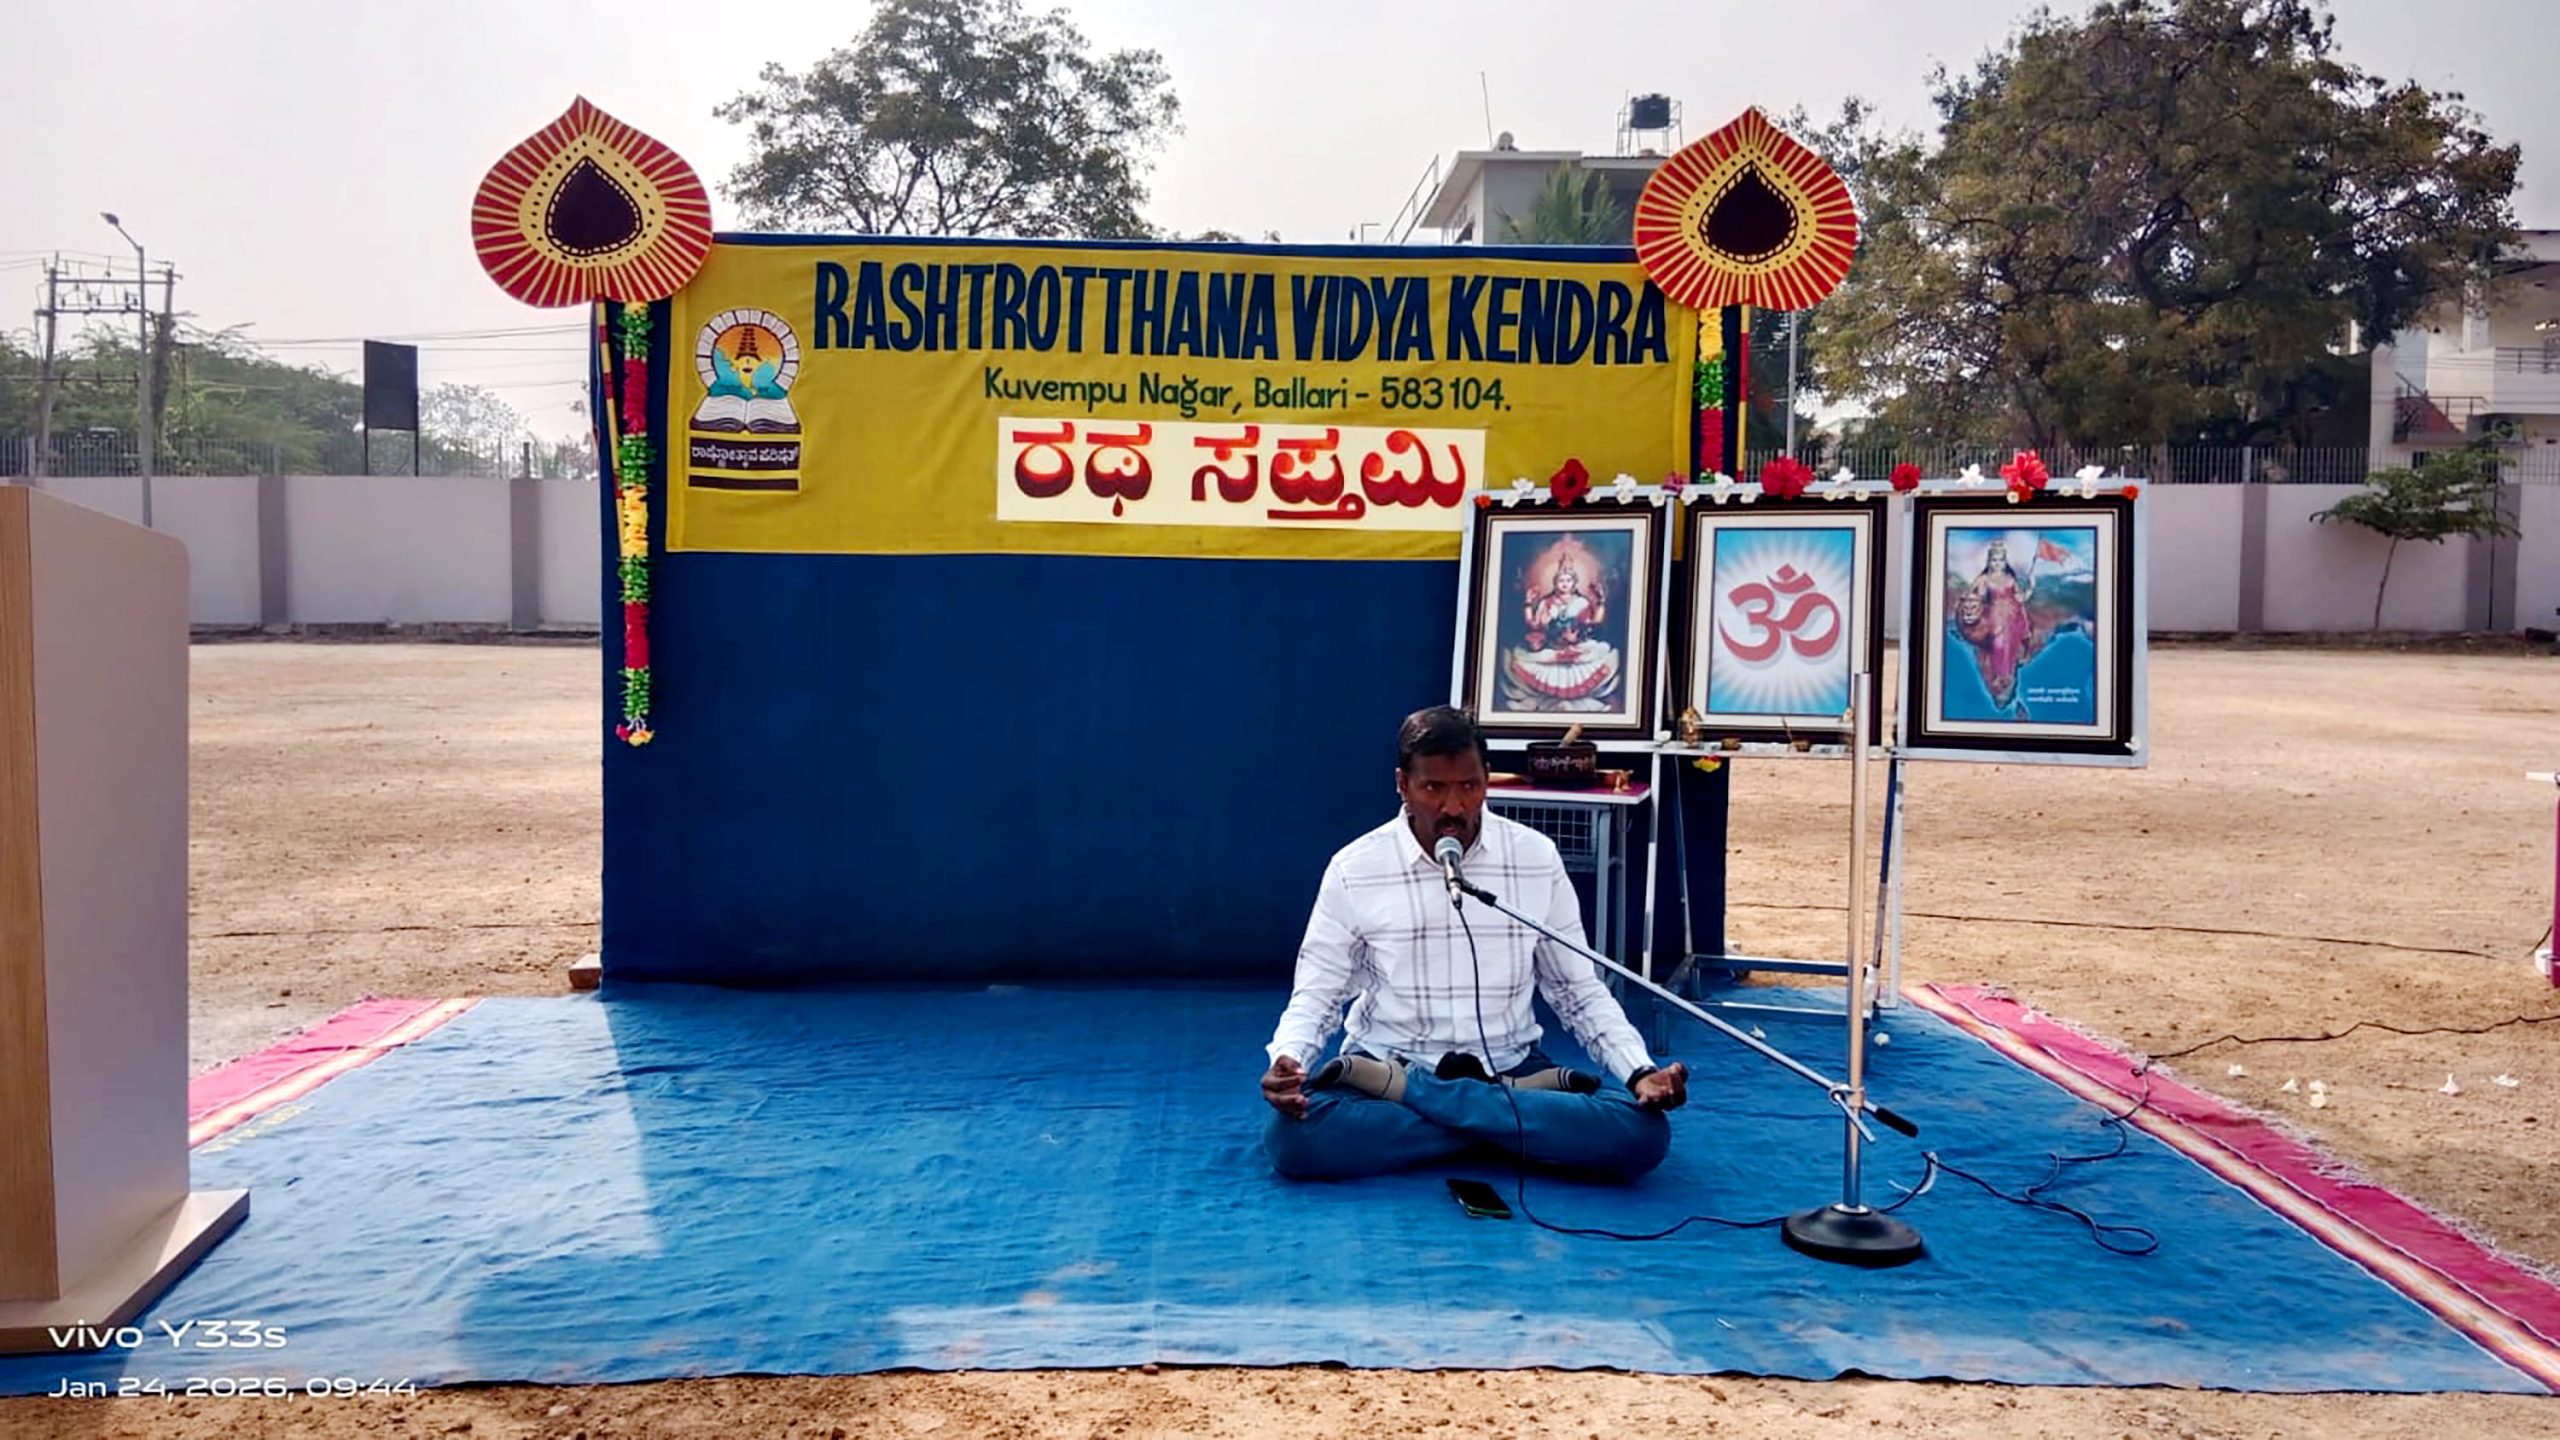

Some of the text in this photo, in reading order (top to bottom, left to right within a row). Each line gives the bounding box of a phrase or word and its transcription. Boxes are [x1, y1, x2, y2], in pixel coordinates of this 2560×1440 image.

[814, 261, 1670, 366] RASHTROTTHANA VIDYA KENDRA
[984, 366, 1127, 413] Kuvempu
[1254, 377, 1348, 409] Ballari
[1012, 422, 1467, 521] ರಥ ಸಪ್ತಮಿ
